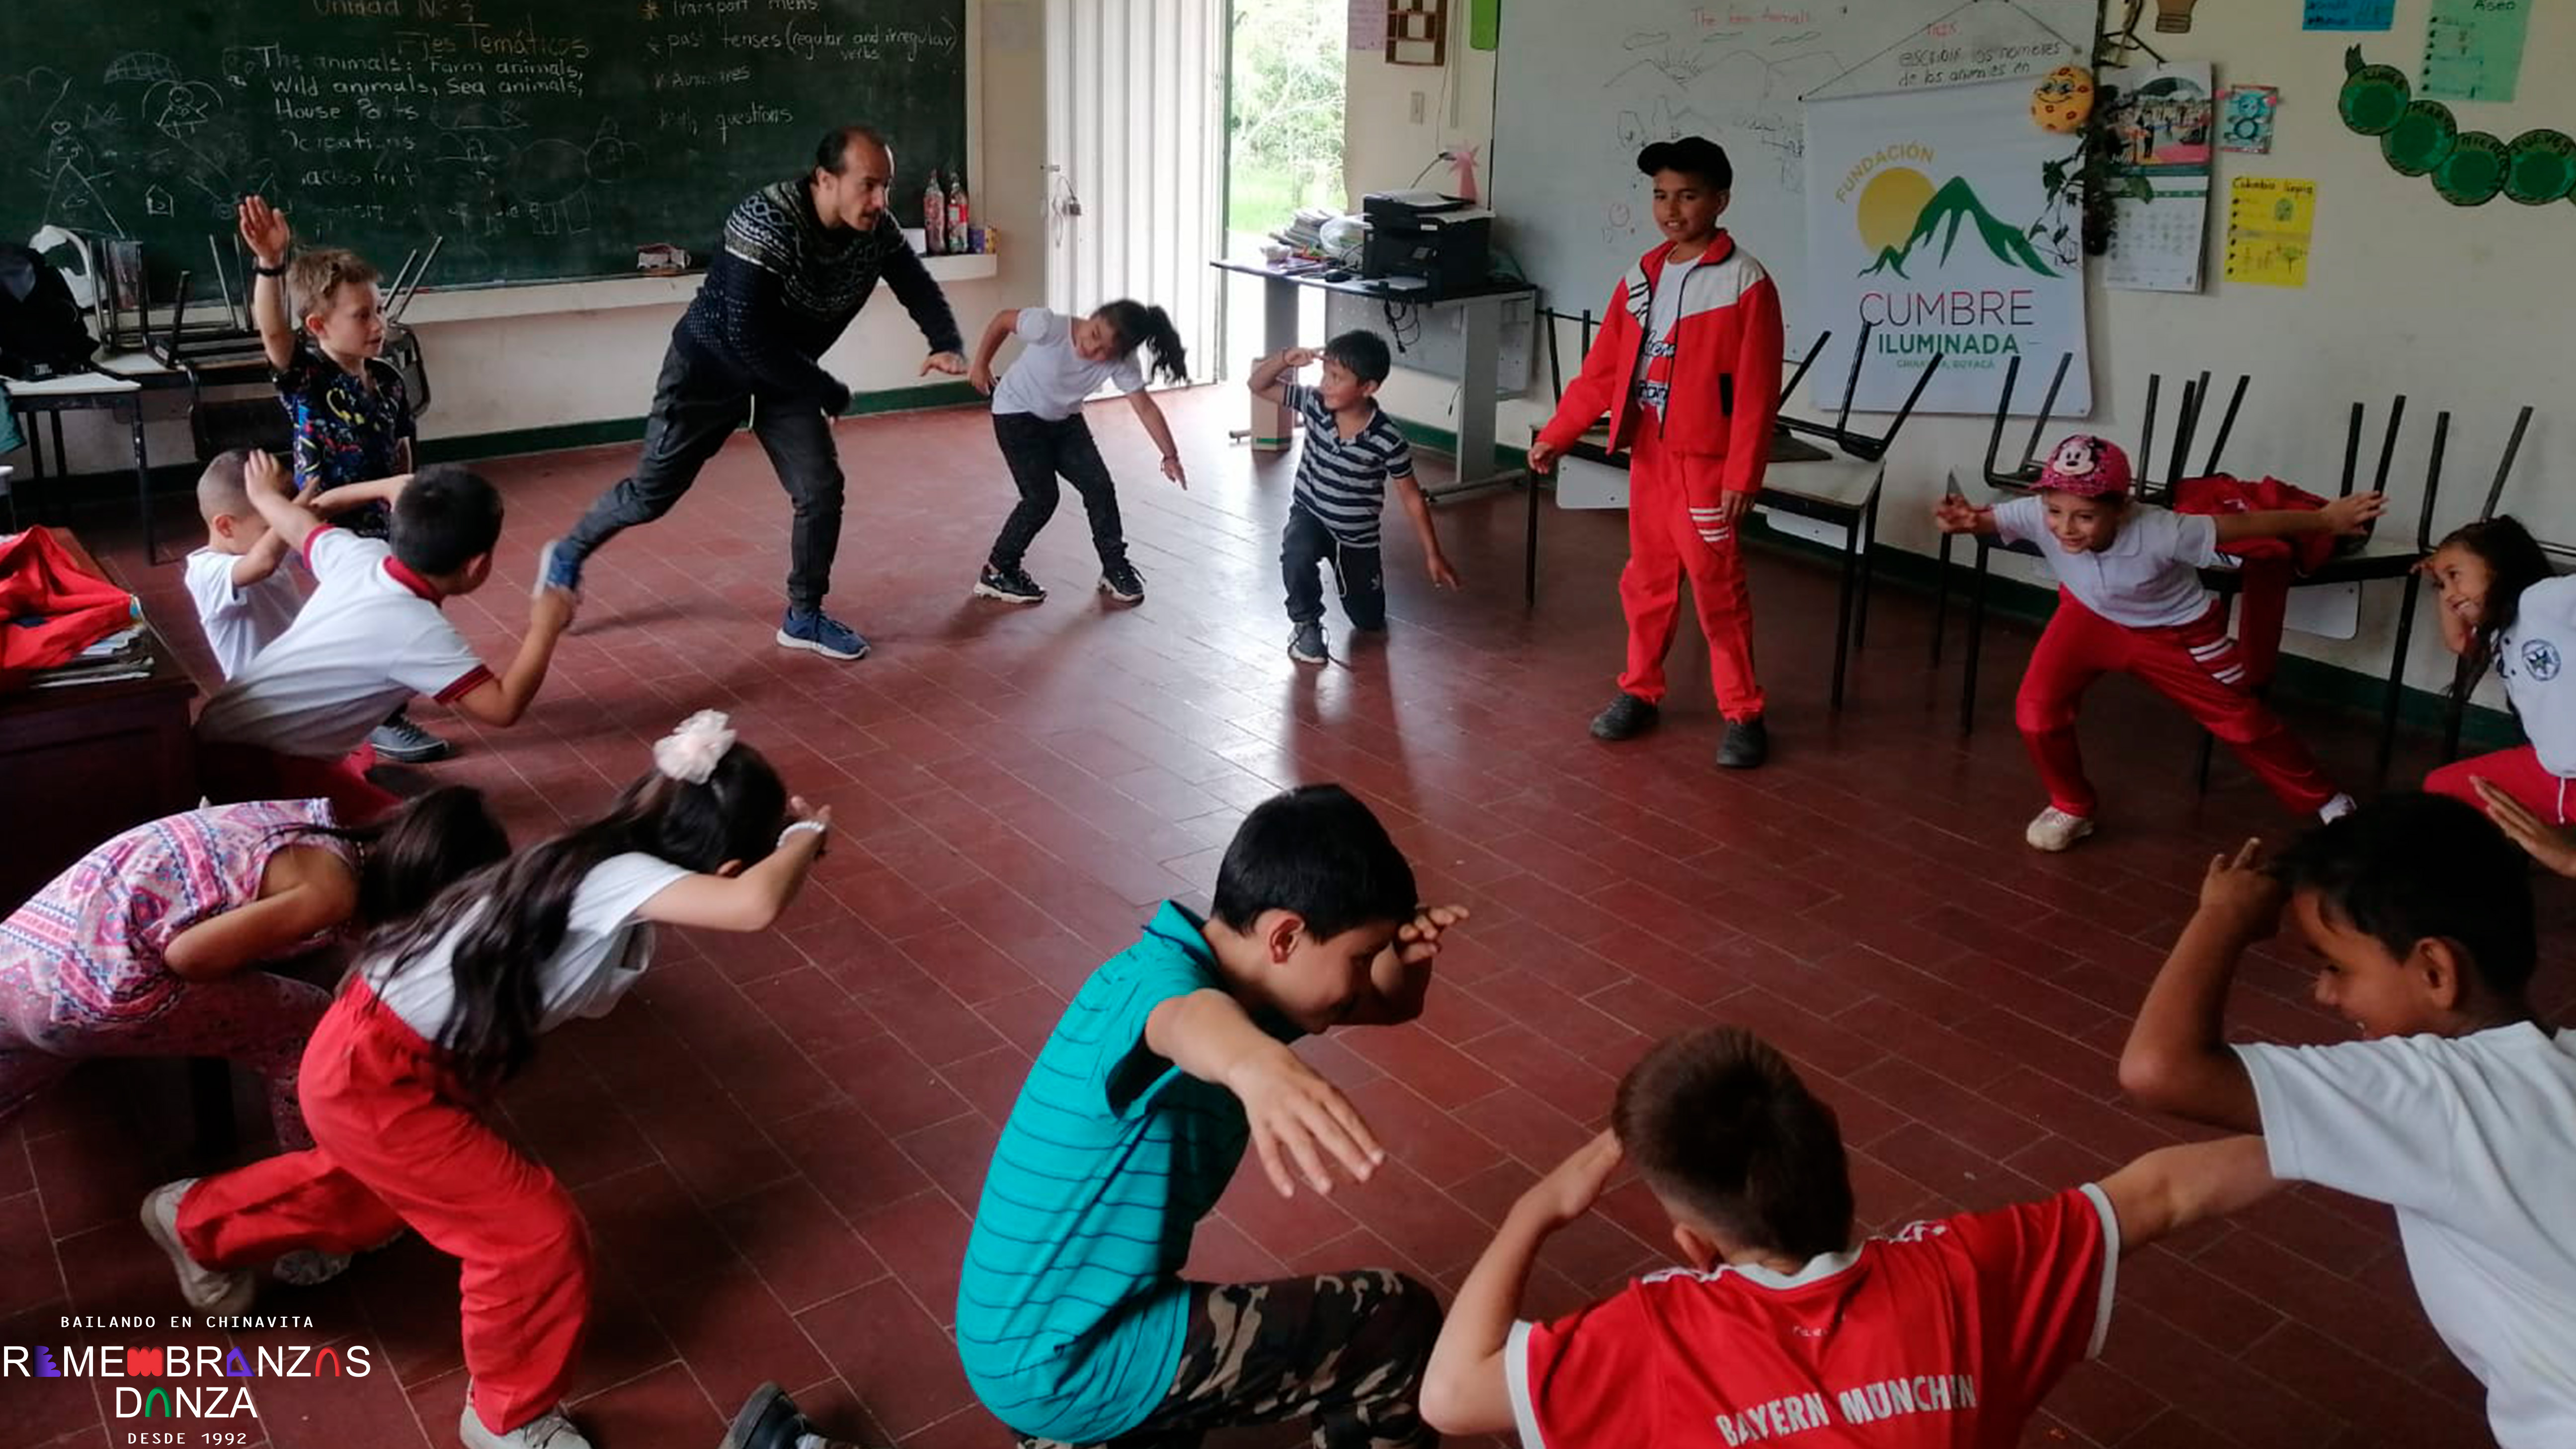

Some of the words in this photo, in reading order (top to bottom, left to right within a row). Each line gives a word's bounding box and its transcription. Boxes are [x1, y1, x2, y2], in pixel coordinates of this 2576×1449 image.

[721, 23, 783, 48] tenses
[853, 24, 879, 44] and
[428, 56, 483, 74] Farm
[269, 74, 320, 97] Wild
[331, 73, 439, 97] animals,
[446, 77, 487, 96] Sea
[497, 77, 583, 98] animals,
[275, 98, 341, 119] House
[714, 100, 795, 148] questions
[1835, 140, 1934, 204] FUNDACIÓN
[1859, 290, 2034, 326] CUMBRE
[1878, 333, 2020, 354] ILUMINADA
[1715, 1391, 1830, 1448] BAYERN
